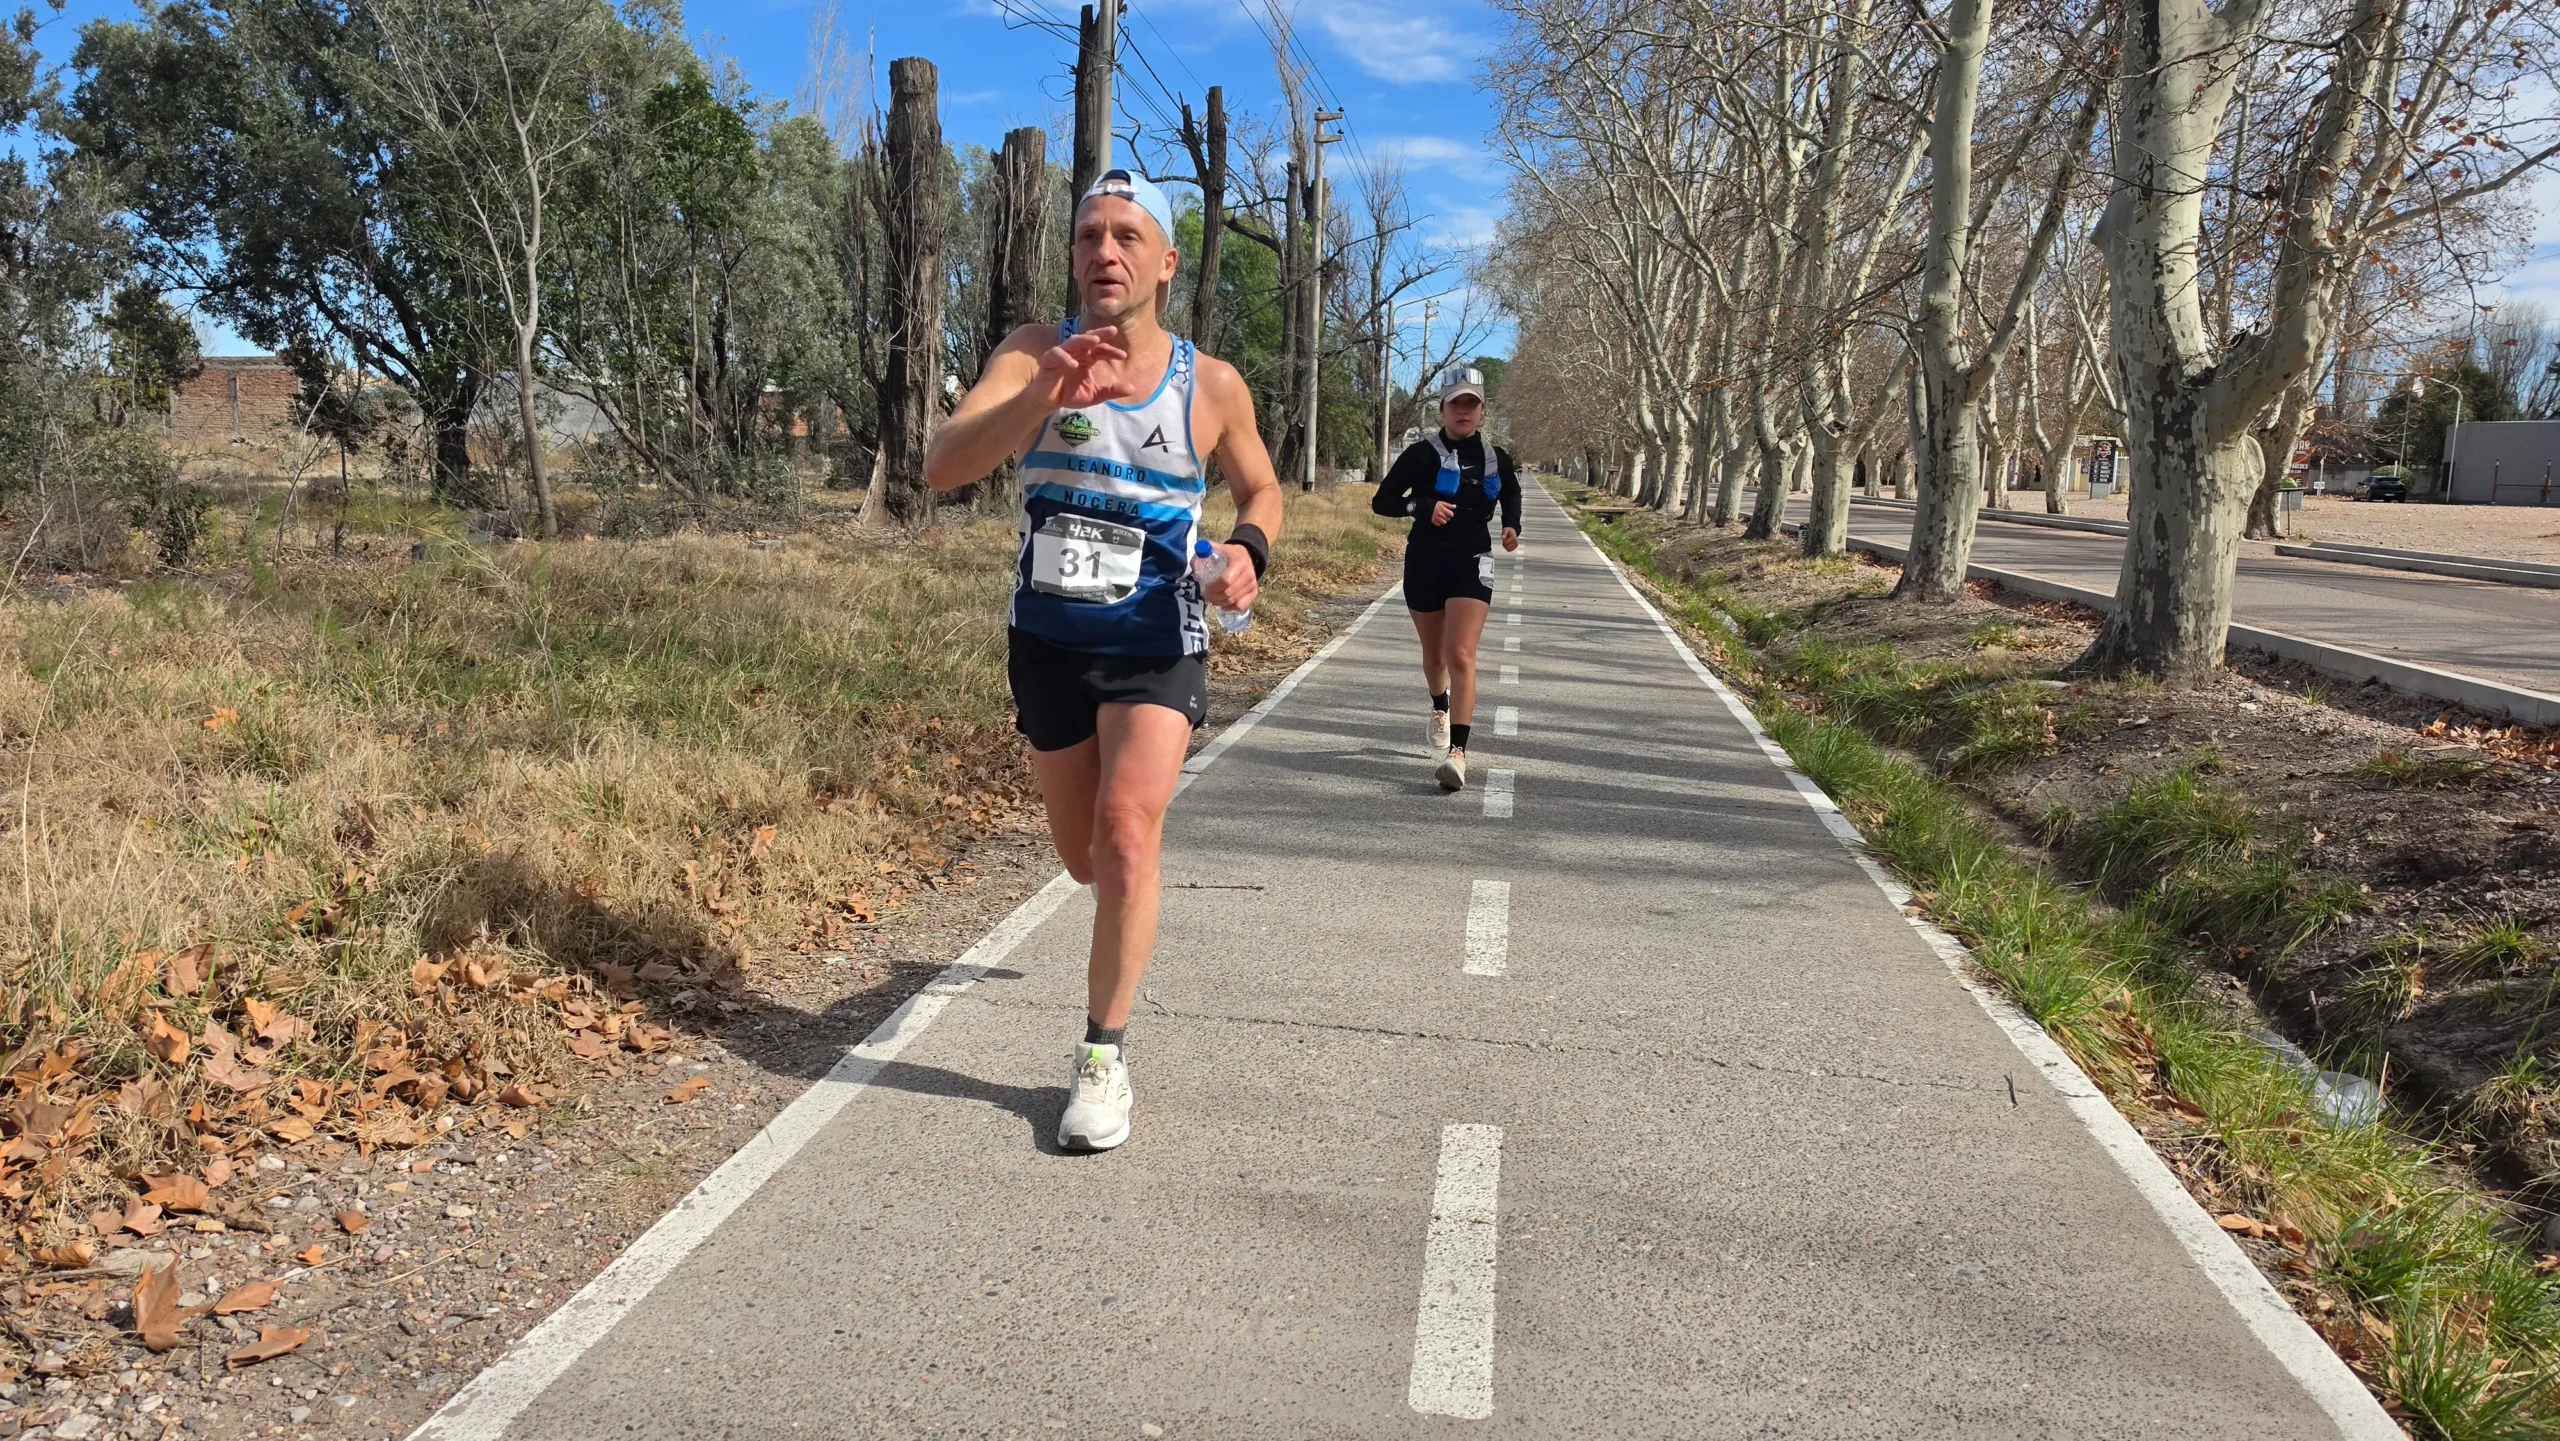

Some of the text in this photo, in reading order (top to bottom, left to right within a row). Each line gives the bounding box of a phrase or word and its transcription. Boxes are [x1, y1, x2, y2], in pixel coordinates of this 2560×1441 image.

[1067, 459, 1146, 482] LEANDRO
[1064, 490, 1139, 515] NOCERA
[1069, 523, 1105, 540] 42K
[1058, 548, 1101, 579] 31
